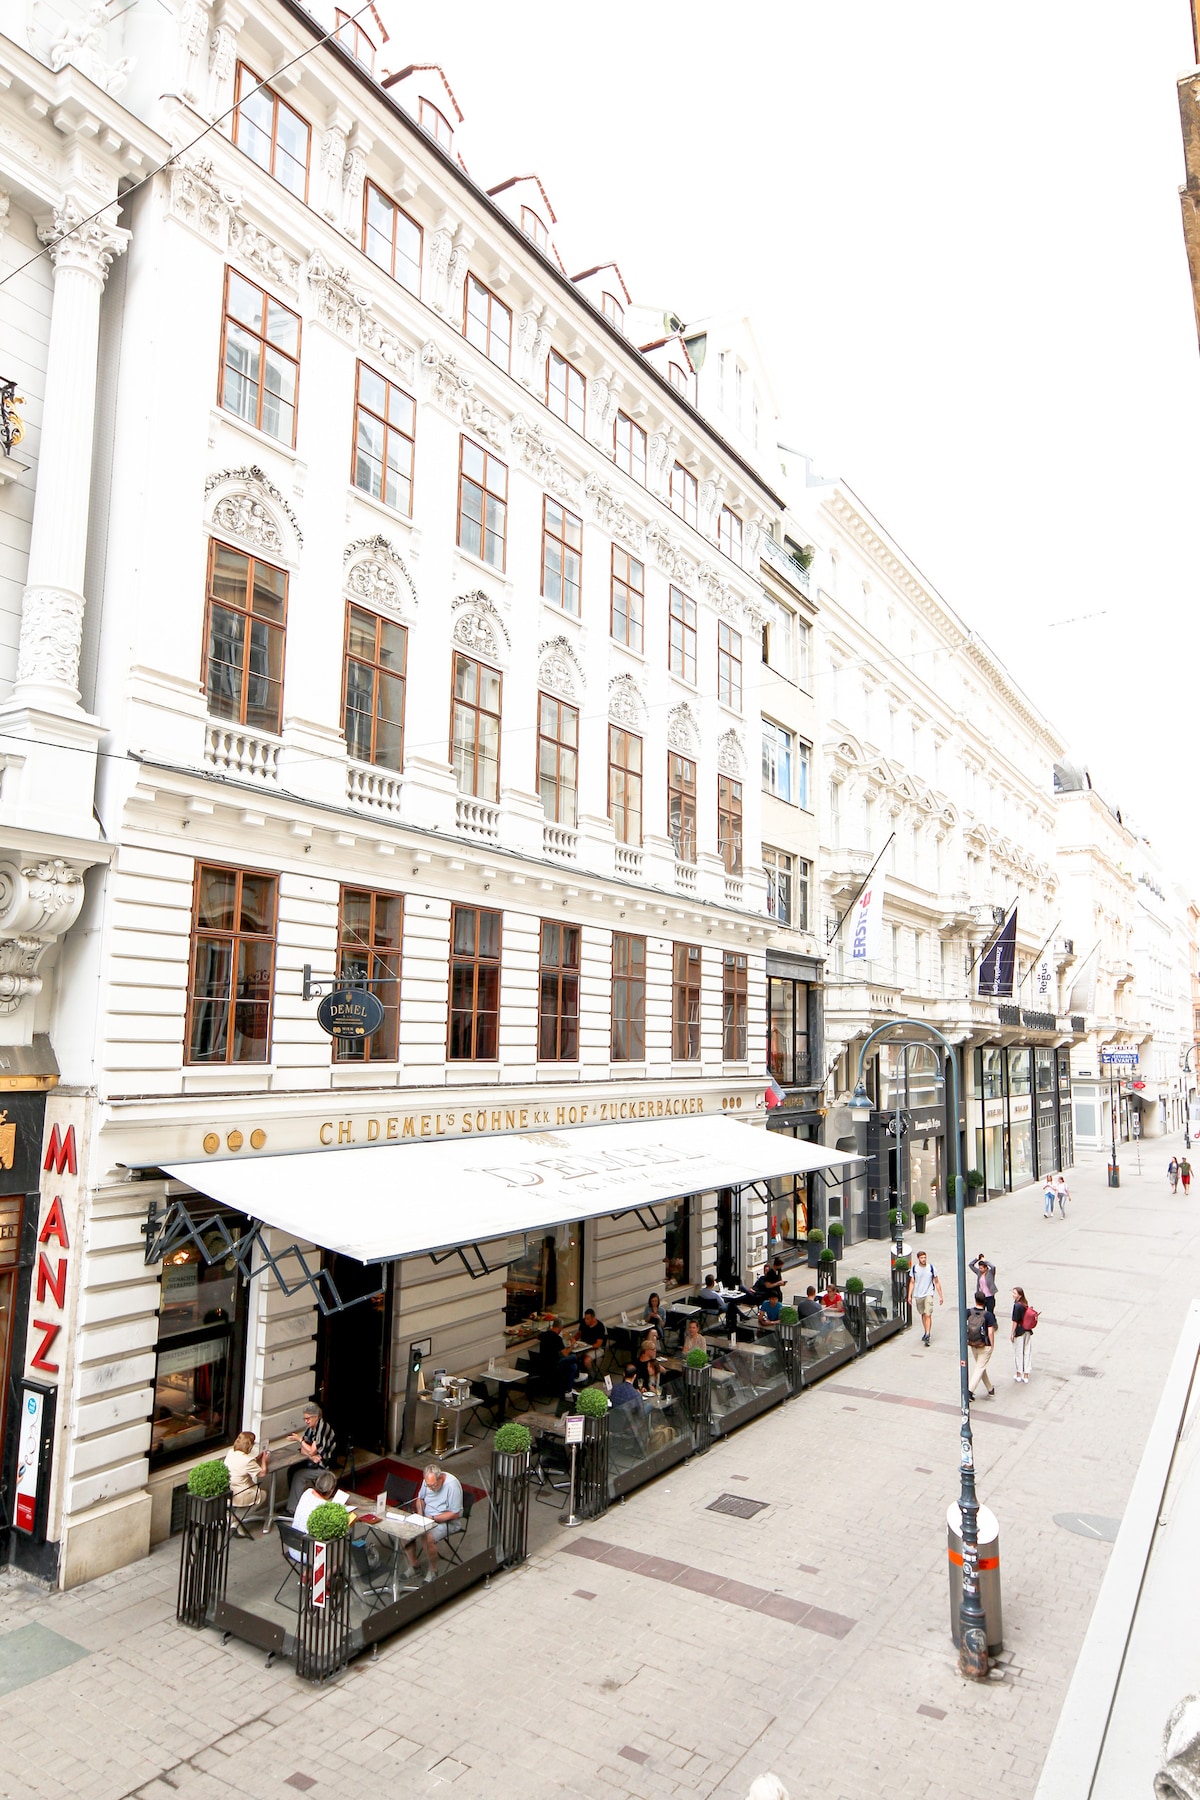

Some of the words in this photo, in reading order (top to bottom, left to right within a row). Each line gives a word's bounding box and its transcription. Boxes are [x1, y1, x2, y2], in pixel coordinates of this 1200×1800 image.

[853, 908, 868, 958] ERSTE
[1039, 962, 1051, 994] Regus
[330, 1003, 367, 1017] DEMEL
[319, 1120, 356, 1146] CH.
[461, 1108, 529, 1133] SÖHNE
[600, 1097, 704, 1121] ZUCKERBÄCKER
[463, 1143, 712, 1188] DEMEL
[30, 1122, 78, 1374] MANZ
